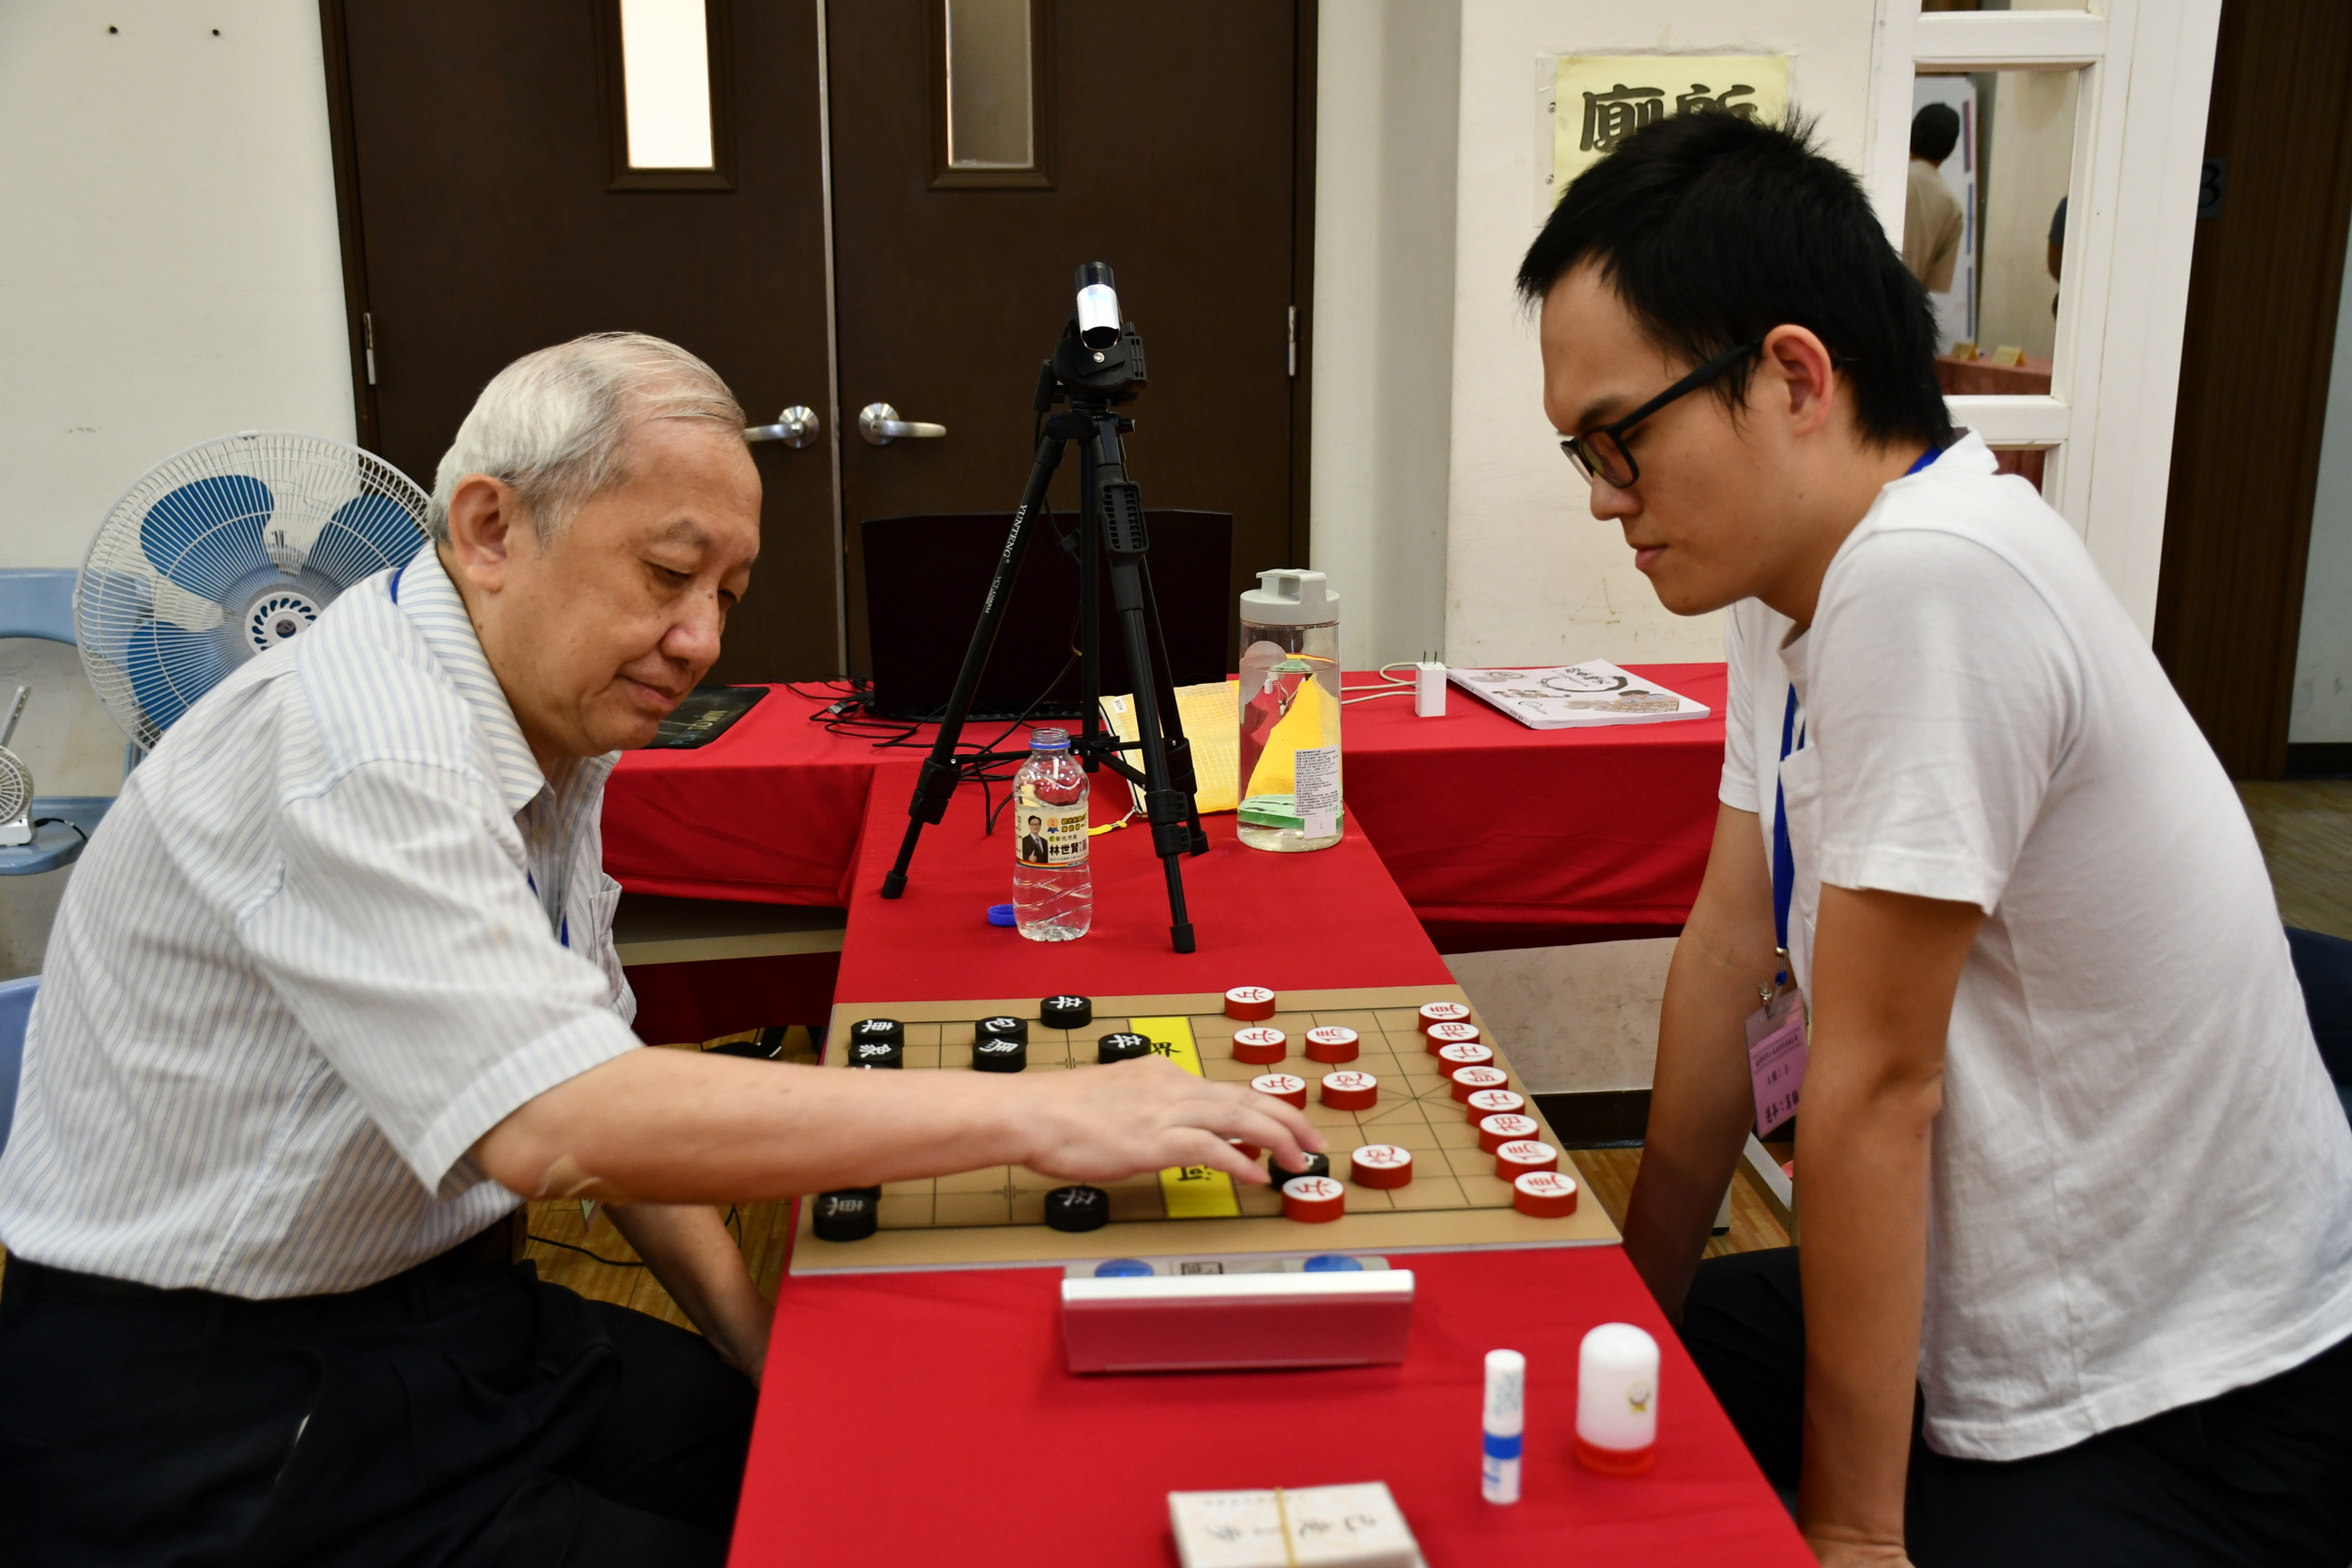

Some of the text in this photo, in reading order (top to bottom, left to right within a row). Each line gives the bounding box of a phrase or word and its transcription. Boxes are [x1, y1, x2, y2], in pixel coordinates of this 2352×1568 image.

[1003, 504, 1028, 558] YUNTENG
[1049, 842, 1079, 856] 林世賢
[1235, 989, 1266, 1000] 兵
[1050, 996, 1082, 1009] 卒
[860, 1020, 894, 1033] 車
[1108, 1034, 1142, 1048] 卒
[1244, 1030, 1276, 1043] 兵
[1261, 1076, 1297, 1091] 兵
[1294, 1180, 1333, 1197] 兵
